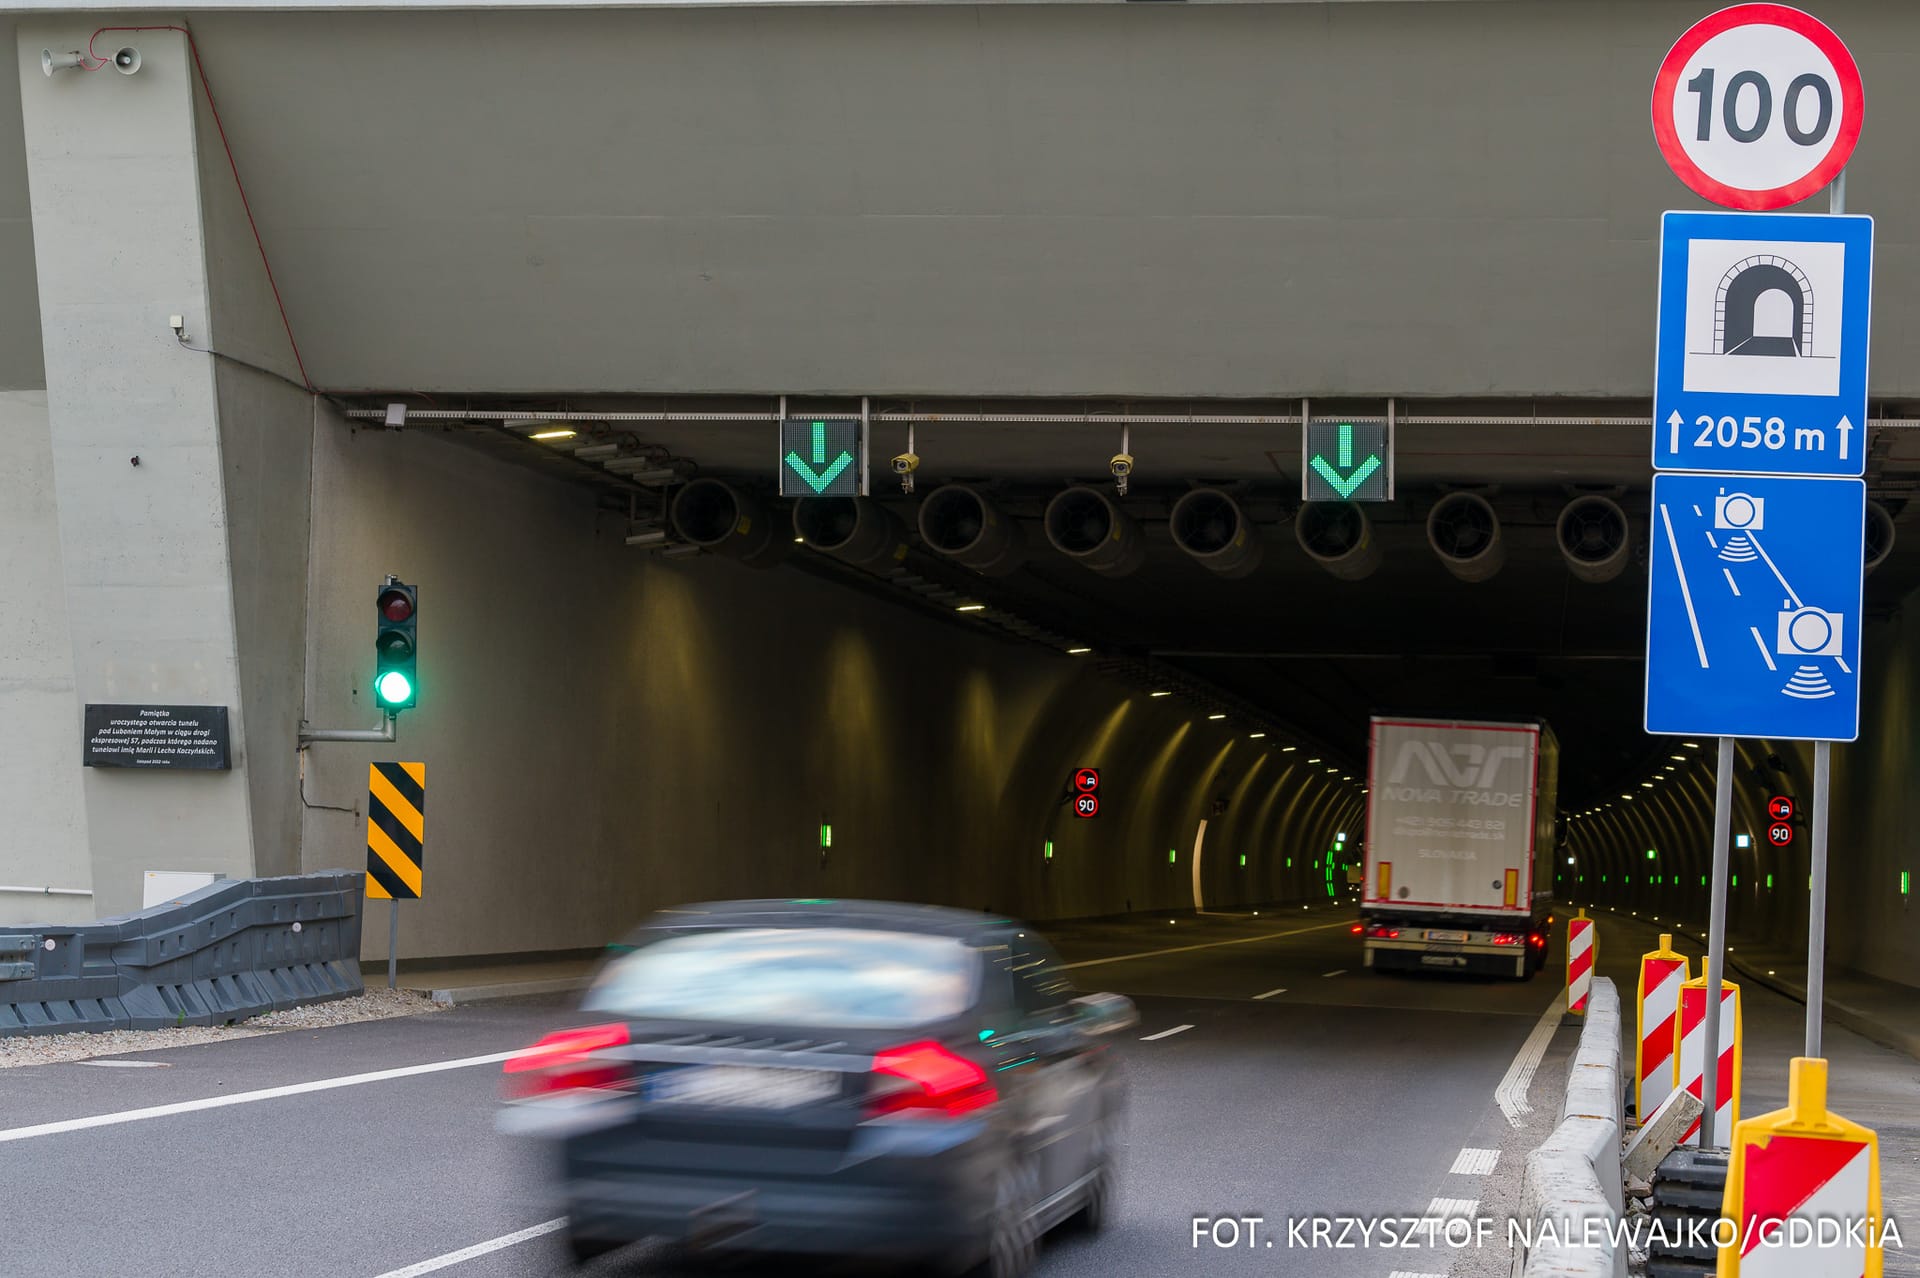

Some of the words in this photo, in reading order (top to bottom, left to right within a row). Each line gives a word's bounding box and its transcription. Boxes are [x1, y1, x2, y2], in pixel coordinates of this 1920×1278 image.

[1687, 67, 1833, 146] 100
[1693, 415, 1785, 450] 2058
[1794, 428, 1825, 451] m
[140, 709, 170, 718] Pamiątka
[110, 719, 147, 727] uroczystego
[178, 719, 199, 727] tunelu
[98, 728, 111, 736] pod
[144, 728, 166, 736] Małym
[174, 728, 191, 737] ciągu
[193, 729, 210, 738] drogi
[91, 737, 130, 745] ekspresowej
[141, 738, 166, 746] podczas
[167, 738, 192, 746] którego
[193, 738, 217, 746] nadano
[120, 746, 134, 754] imię
[1381, 786, 1441, 804] NOVA
[1450, 790, 1523, 807] TRADE
[1079, 799, 1095, 812] 90
[1772, 828, 1788, 840] 90
